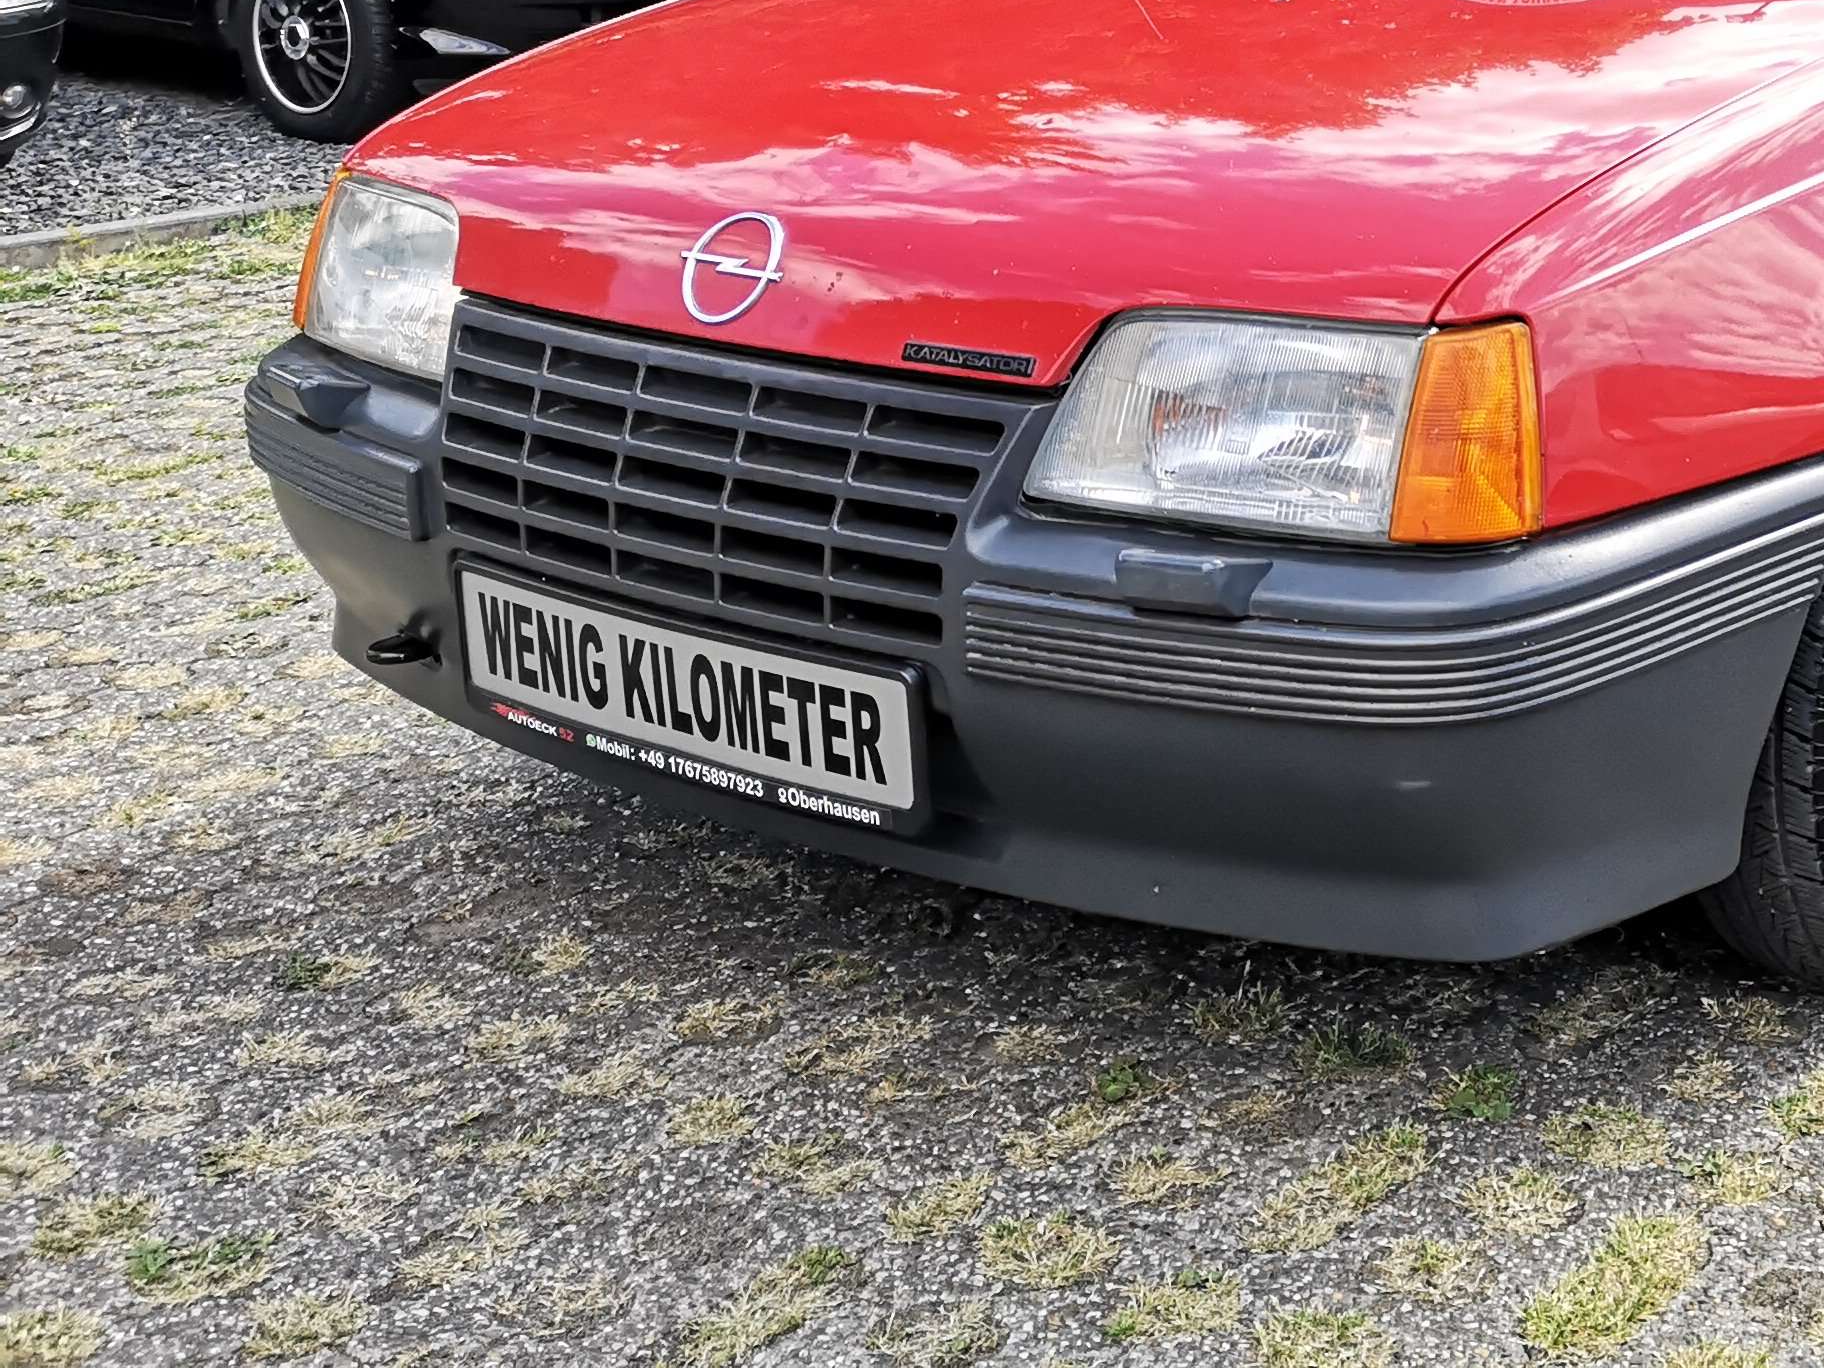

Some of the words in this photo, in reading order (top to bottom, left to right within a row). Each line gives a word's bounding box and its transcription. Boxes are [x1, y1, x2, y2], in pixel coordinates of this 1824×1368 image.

[903, 344, 1028, 373] KATALYSATOR
[477, 591, 610, 711] WENIG
[618, 634, 888, 787] KILOMETER
[506, 711, 558, 737] AUTOECK
[596, 736, 636, 761] Mobil:
[639, 749, 665, 769] +49
[667, 756, 764, 798] 17675897923
[787, 787, 881, 826] Oberhausen
